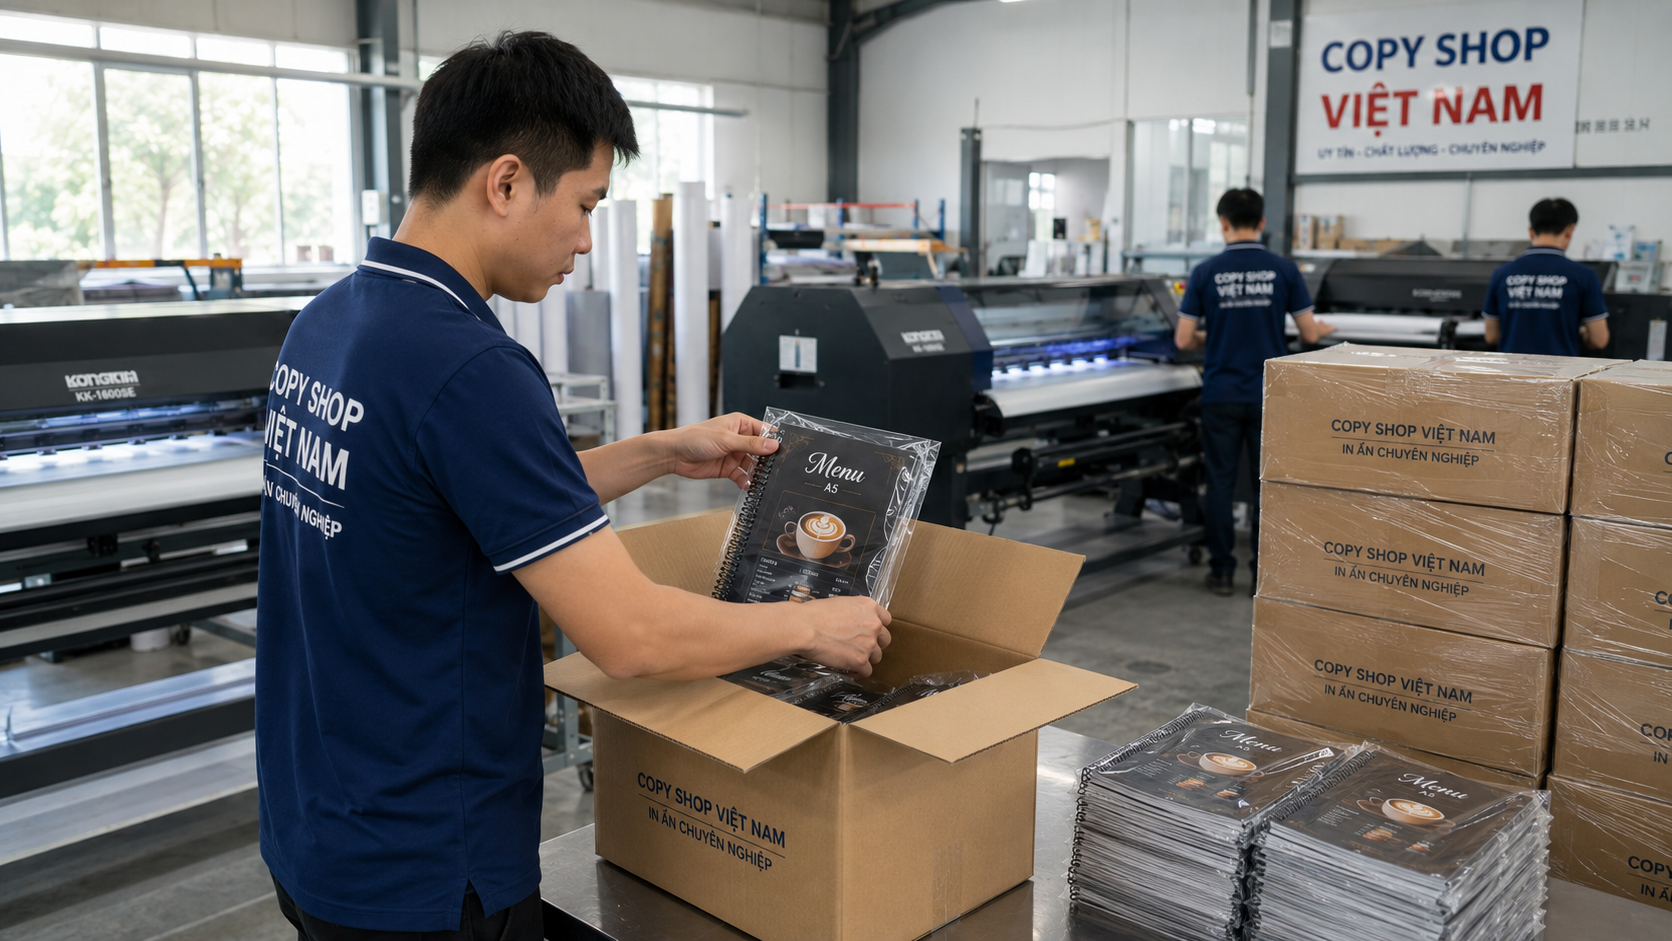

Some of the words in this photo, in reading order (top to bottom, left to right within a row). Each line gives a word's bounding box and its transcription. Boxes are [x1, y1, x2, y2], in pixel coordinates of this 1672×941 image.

[1321, 35, 1425, 73] COPY
[1434, 27, 1550, 67] SHOP
[1321, 82, 1418, 137] VIỆT
[1433, 83, 1543, 125] NAM
[1317, 148, 1332, 159] UY
[1214, 272, 1244, 285] COPY
[1245, 270, 1276, 282] SHOP
[1245, 282, 1274, 295] NAM
[1506, 274, 1535, 286] COPY
[1536, 275, 1568, 286] SHOP
[1534, 286, 1563, 299] NAM
[307, 381, 365, 432] SHOP
[1331, 419, 1372, 434] COPY
[1375, 422, 1417, 438] SHOP
[1421, 423, 1456, 444] VIỆT
[1459, 429, 1496, 445] NAM
[296, 426, 350, 491] NAM
[804, 452, 866, 483] Menu
[1342, 444, 1354, 455] IN
[1377, 446, 1428, 462] CHUYÊN
[1431, 451, 1480, 468] NGHIỆP
[823, 482, 839, 494] A5
[301, 504, 343, 540] NGHIỆP
[1323, 541, 1364, 558] COPY
[1366, 547, 1408, 564] SHOP
[1411, 552, 1446, 572] VIỆT
[1449, 559, 1485, 577] NAM
[1334, 566, 1346, 577] IN
[1369, 571, 1419, 588] CHUYÊN
[1421, 579, 1470, 597] NGHIỆP
[1314, 659, 1353, 678] COPY
[1356, 668, 1397, 687] SHOP
[1400, 677, 1434, 697] VIỆT
[1437, 685, 1473, 704] NAM
[1324, 684, 1336, 696] IN
[1358, 692, 1407, 712] CHUYÊN
[1410, 702, 1457, 723] NGHIỆP
[1219, 729, 1282, 752] Menu
[1653, 751, 1668, 765] IN
[1397, 773, 1469, 799] Menu
[637, 772, 672, 800] COPY
[675, 787, 713, 815] SHOP
[715, 803, 748, 833] VIỆT
[751, 819, 786, 849] NAM
[648, 806, 659, 823] IN
[661, 808, 677, 830] ẤN
[679, 820, 725, 852] CHUYÊN
[727, 840, 773, 872] NGHIỆP
[1641, 883, 1656, 898] IN
